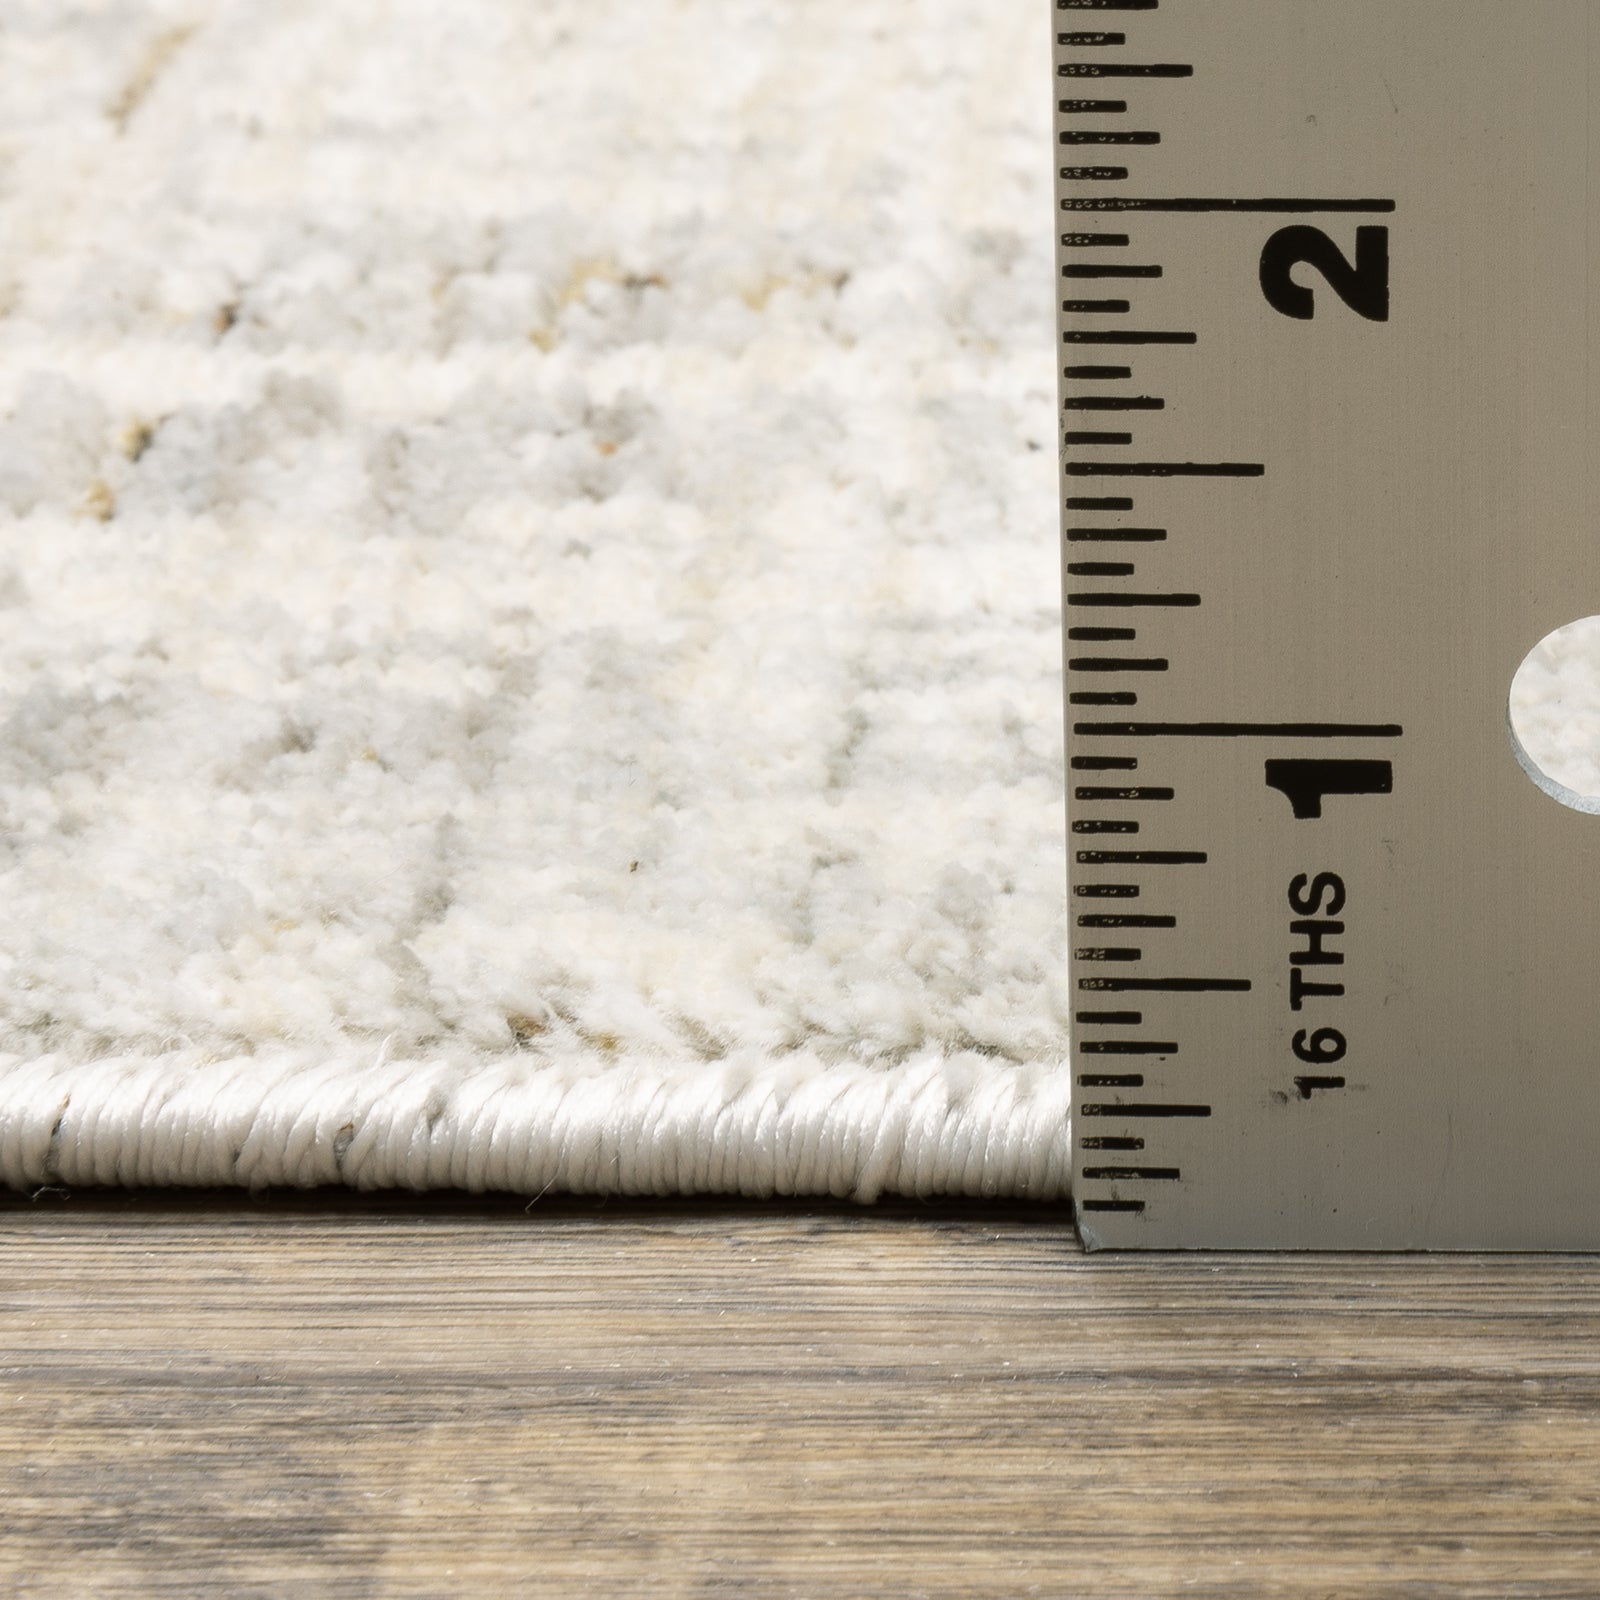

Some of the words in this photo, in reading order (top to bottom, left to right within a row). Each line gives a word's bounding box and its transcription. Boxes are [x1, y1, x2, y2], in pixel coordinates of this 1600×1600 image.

[1257, 223, 1391, 324] 2
[1263, 757, 1395, 821] 1
[1286, 870, 1347, 1013] THS
[1290, 1025, 1349, 1103] 16
